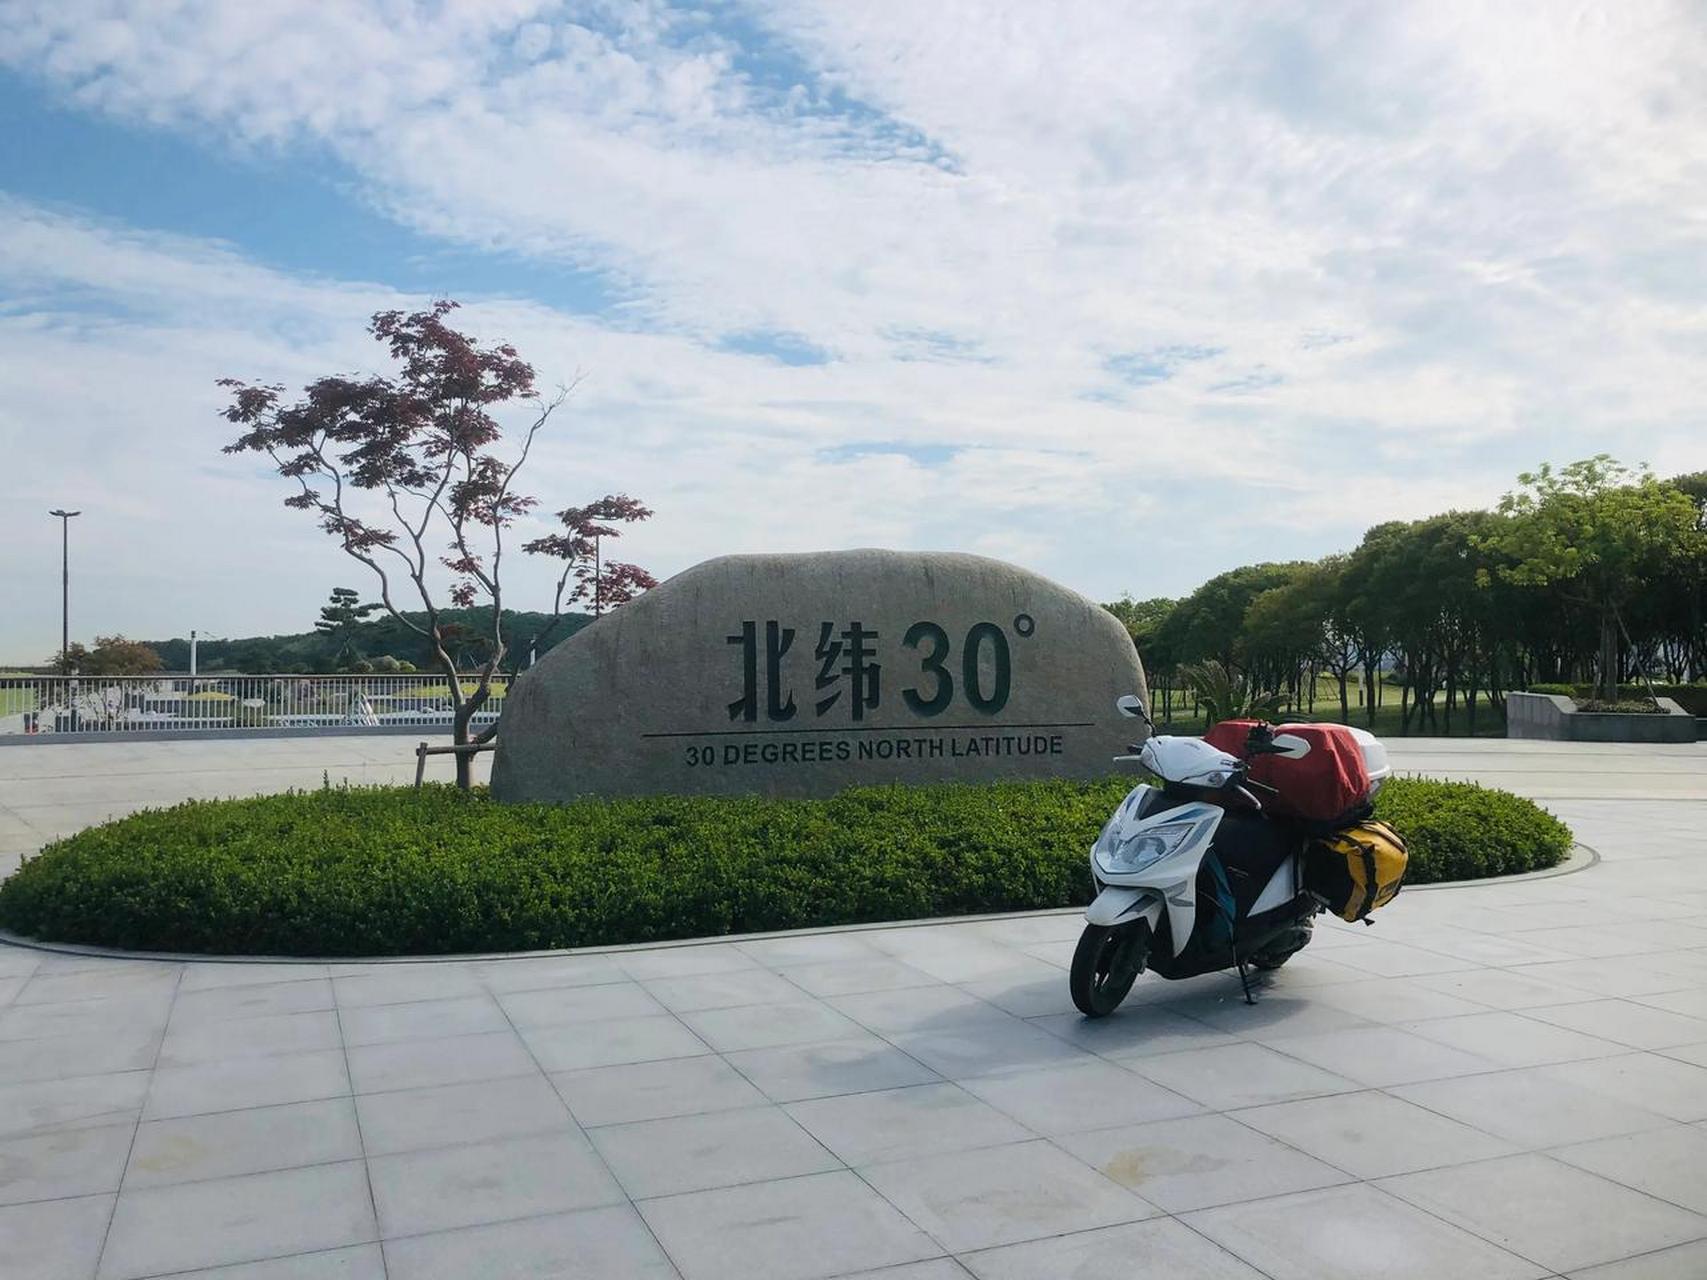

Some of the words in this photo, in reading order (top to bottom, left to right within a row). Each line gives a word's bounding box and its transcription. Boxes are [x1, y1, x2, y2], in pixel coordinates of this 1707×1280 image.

[686, 747, 715, 767] 30
[723, 742, 851, 766] DEGREES
[858, 739, 944, 760] NORTH
[951, 736, 1063, 757] LATITUDE
